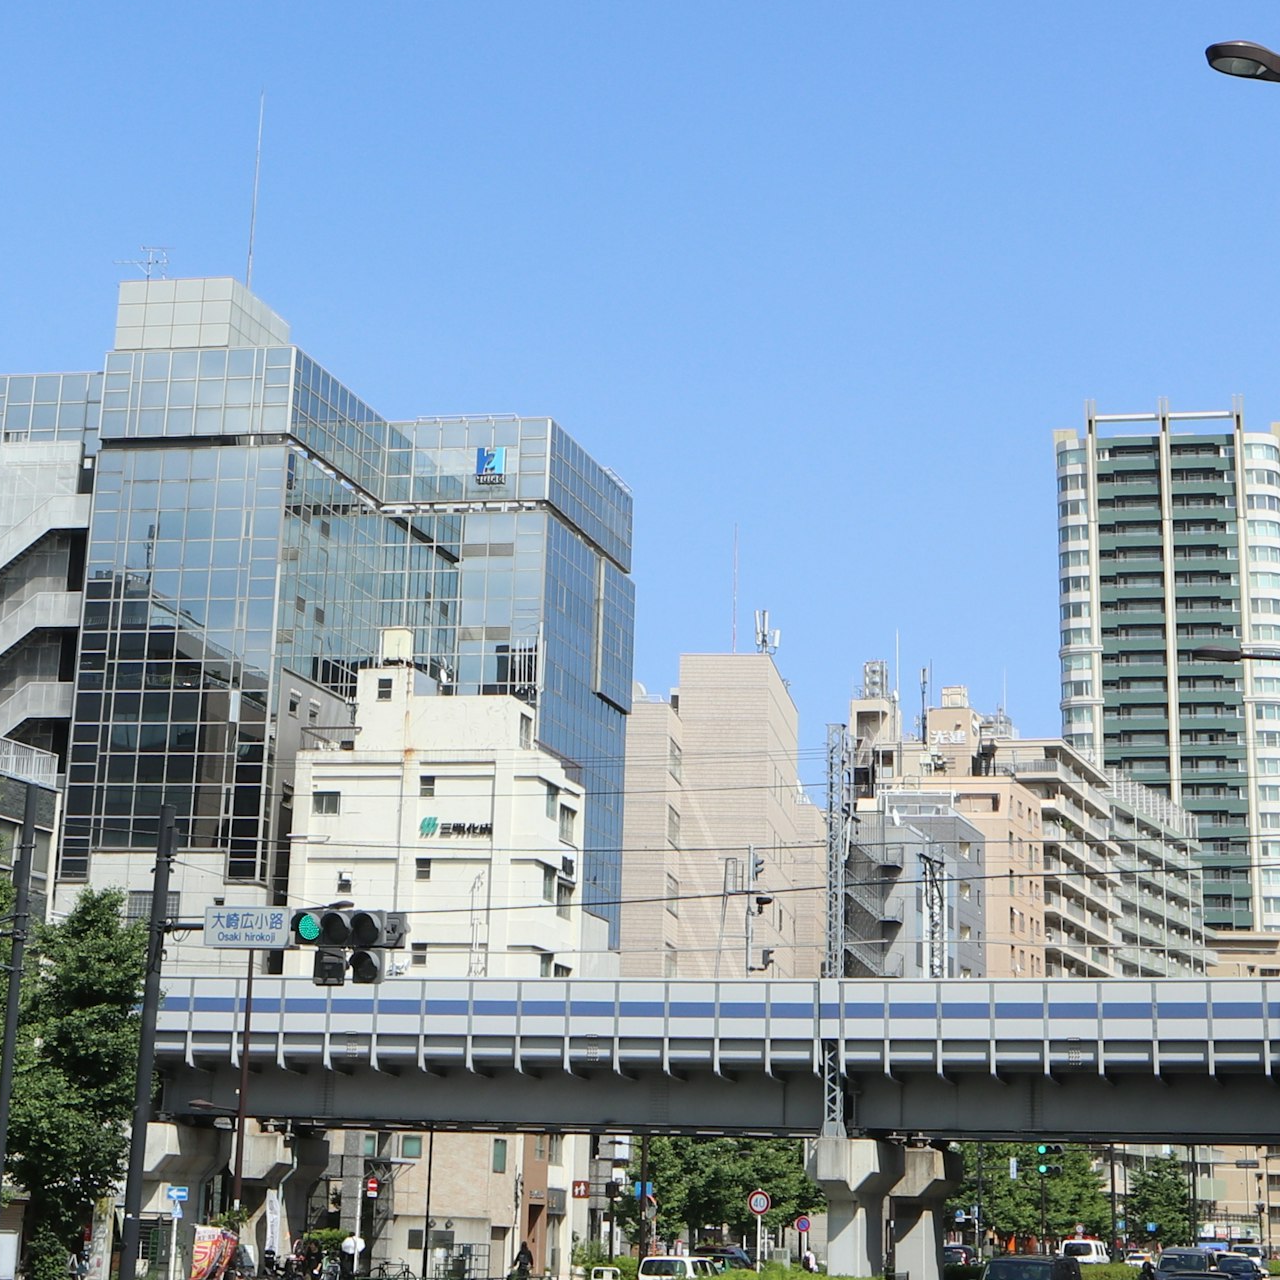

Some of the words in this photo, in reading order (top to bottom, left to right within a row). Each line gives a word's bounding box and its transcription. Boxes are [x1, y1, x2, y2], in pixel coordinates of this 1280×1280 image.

[211, 912, 283, 929] 大崎広小路
[217, 932, 241, 941] Osaki
[245, 932, 276, 943] hirokoji
[753, 1198, 766, 1208] 40
